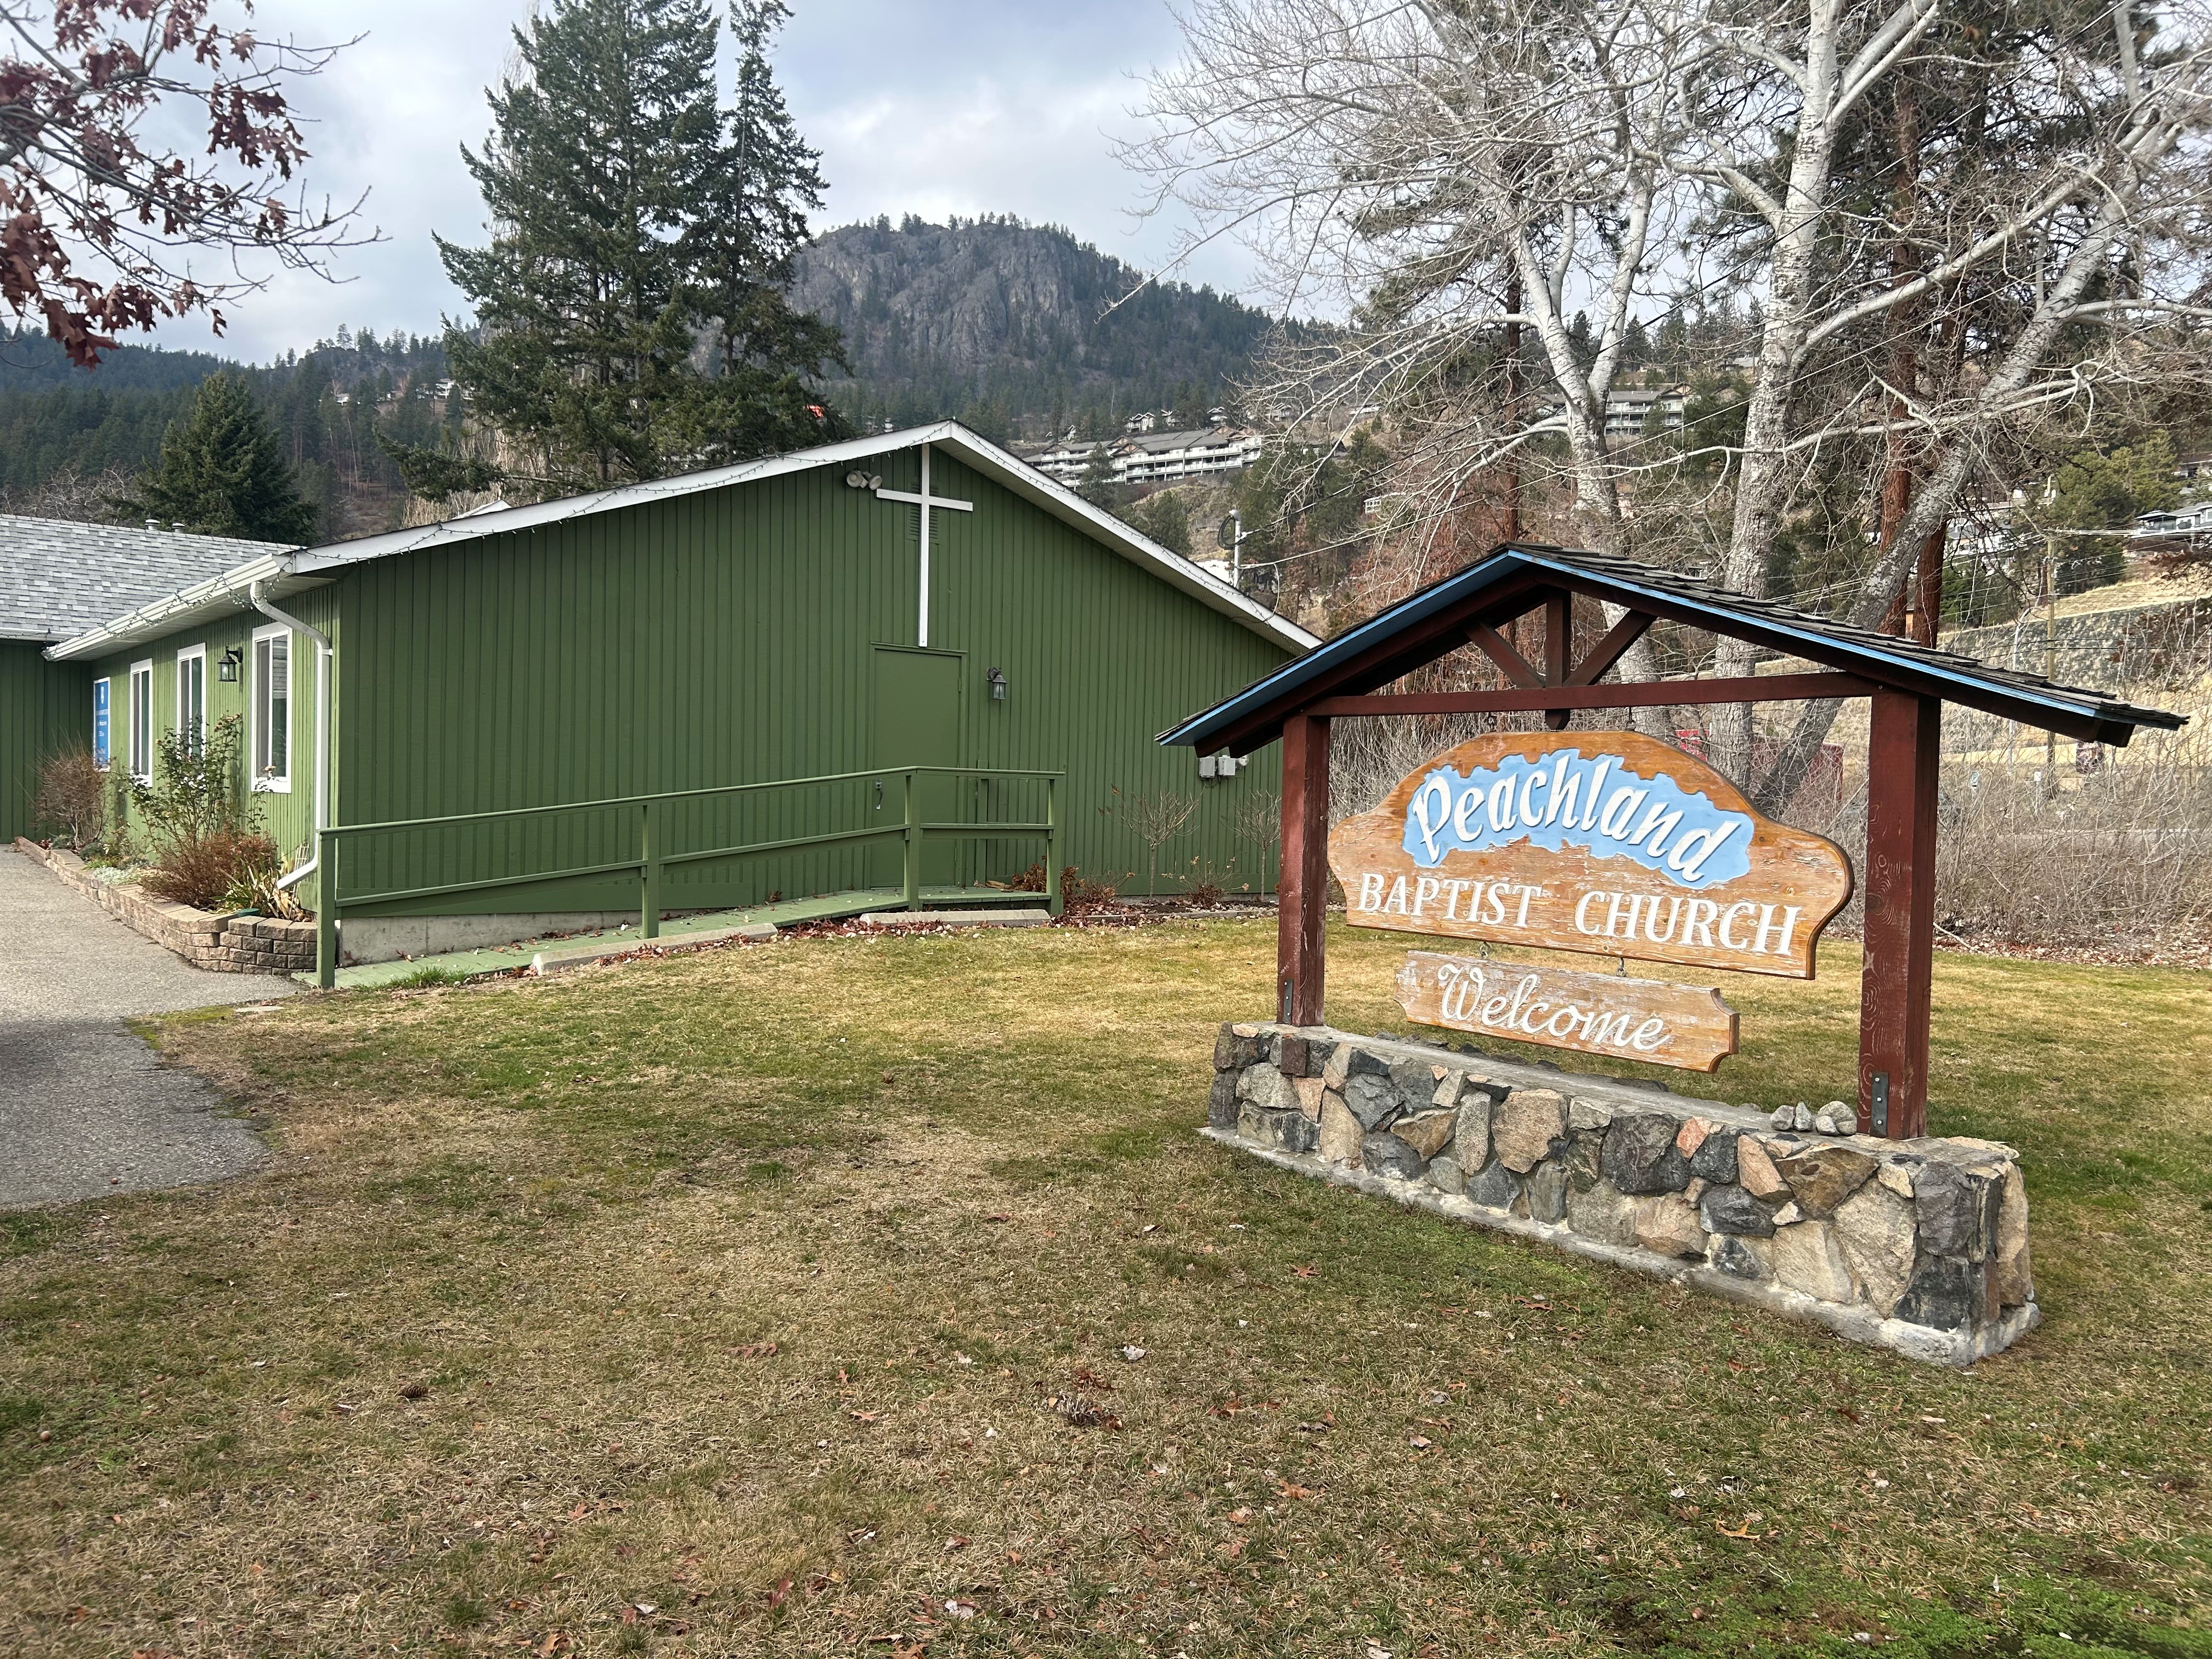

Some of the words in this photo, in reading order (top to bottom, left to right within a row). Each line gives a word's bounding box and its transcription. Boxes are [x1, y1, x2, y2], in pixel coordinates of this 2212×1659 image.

[1413, 755, 1739, 881] Peachland
[1358, 873, 1542, 927] BAPTIST
[1575, 891, 1802, 956] CHURCH
[1437, 963, 1671, 1051] Welcome
